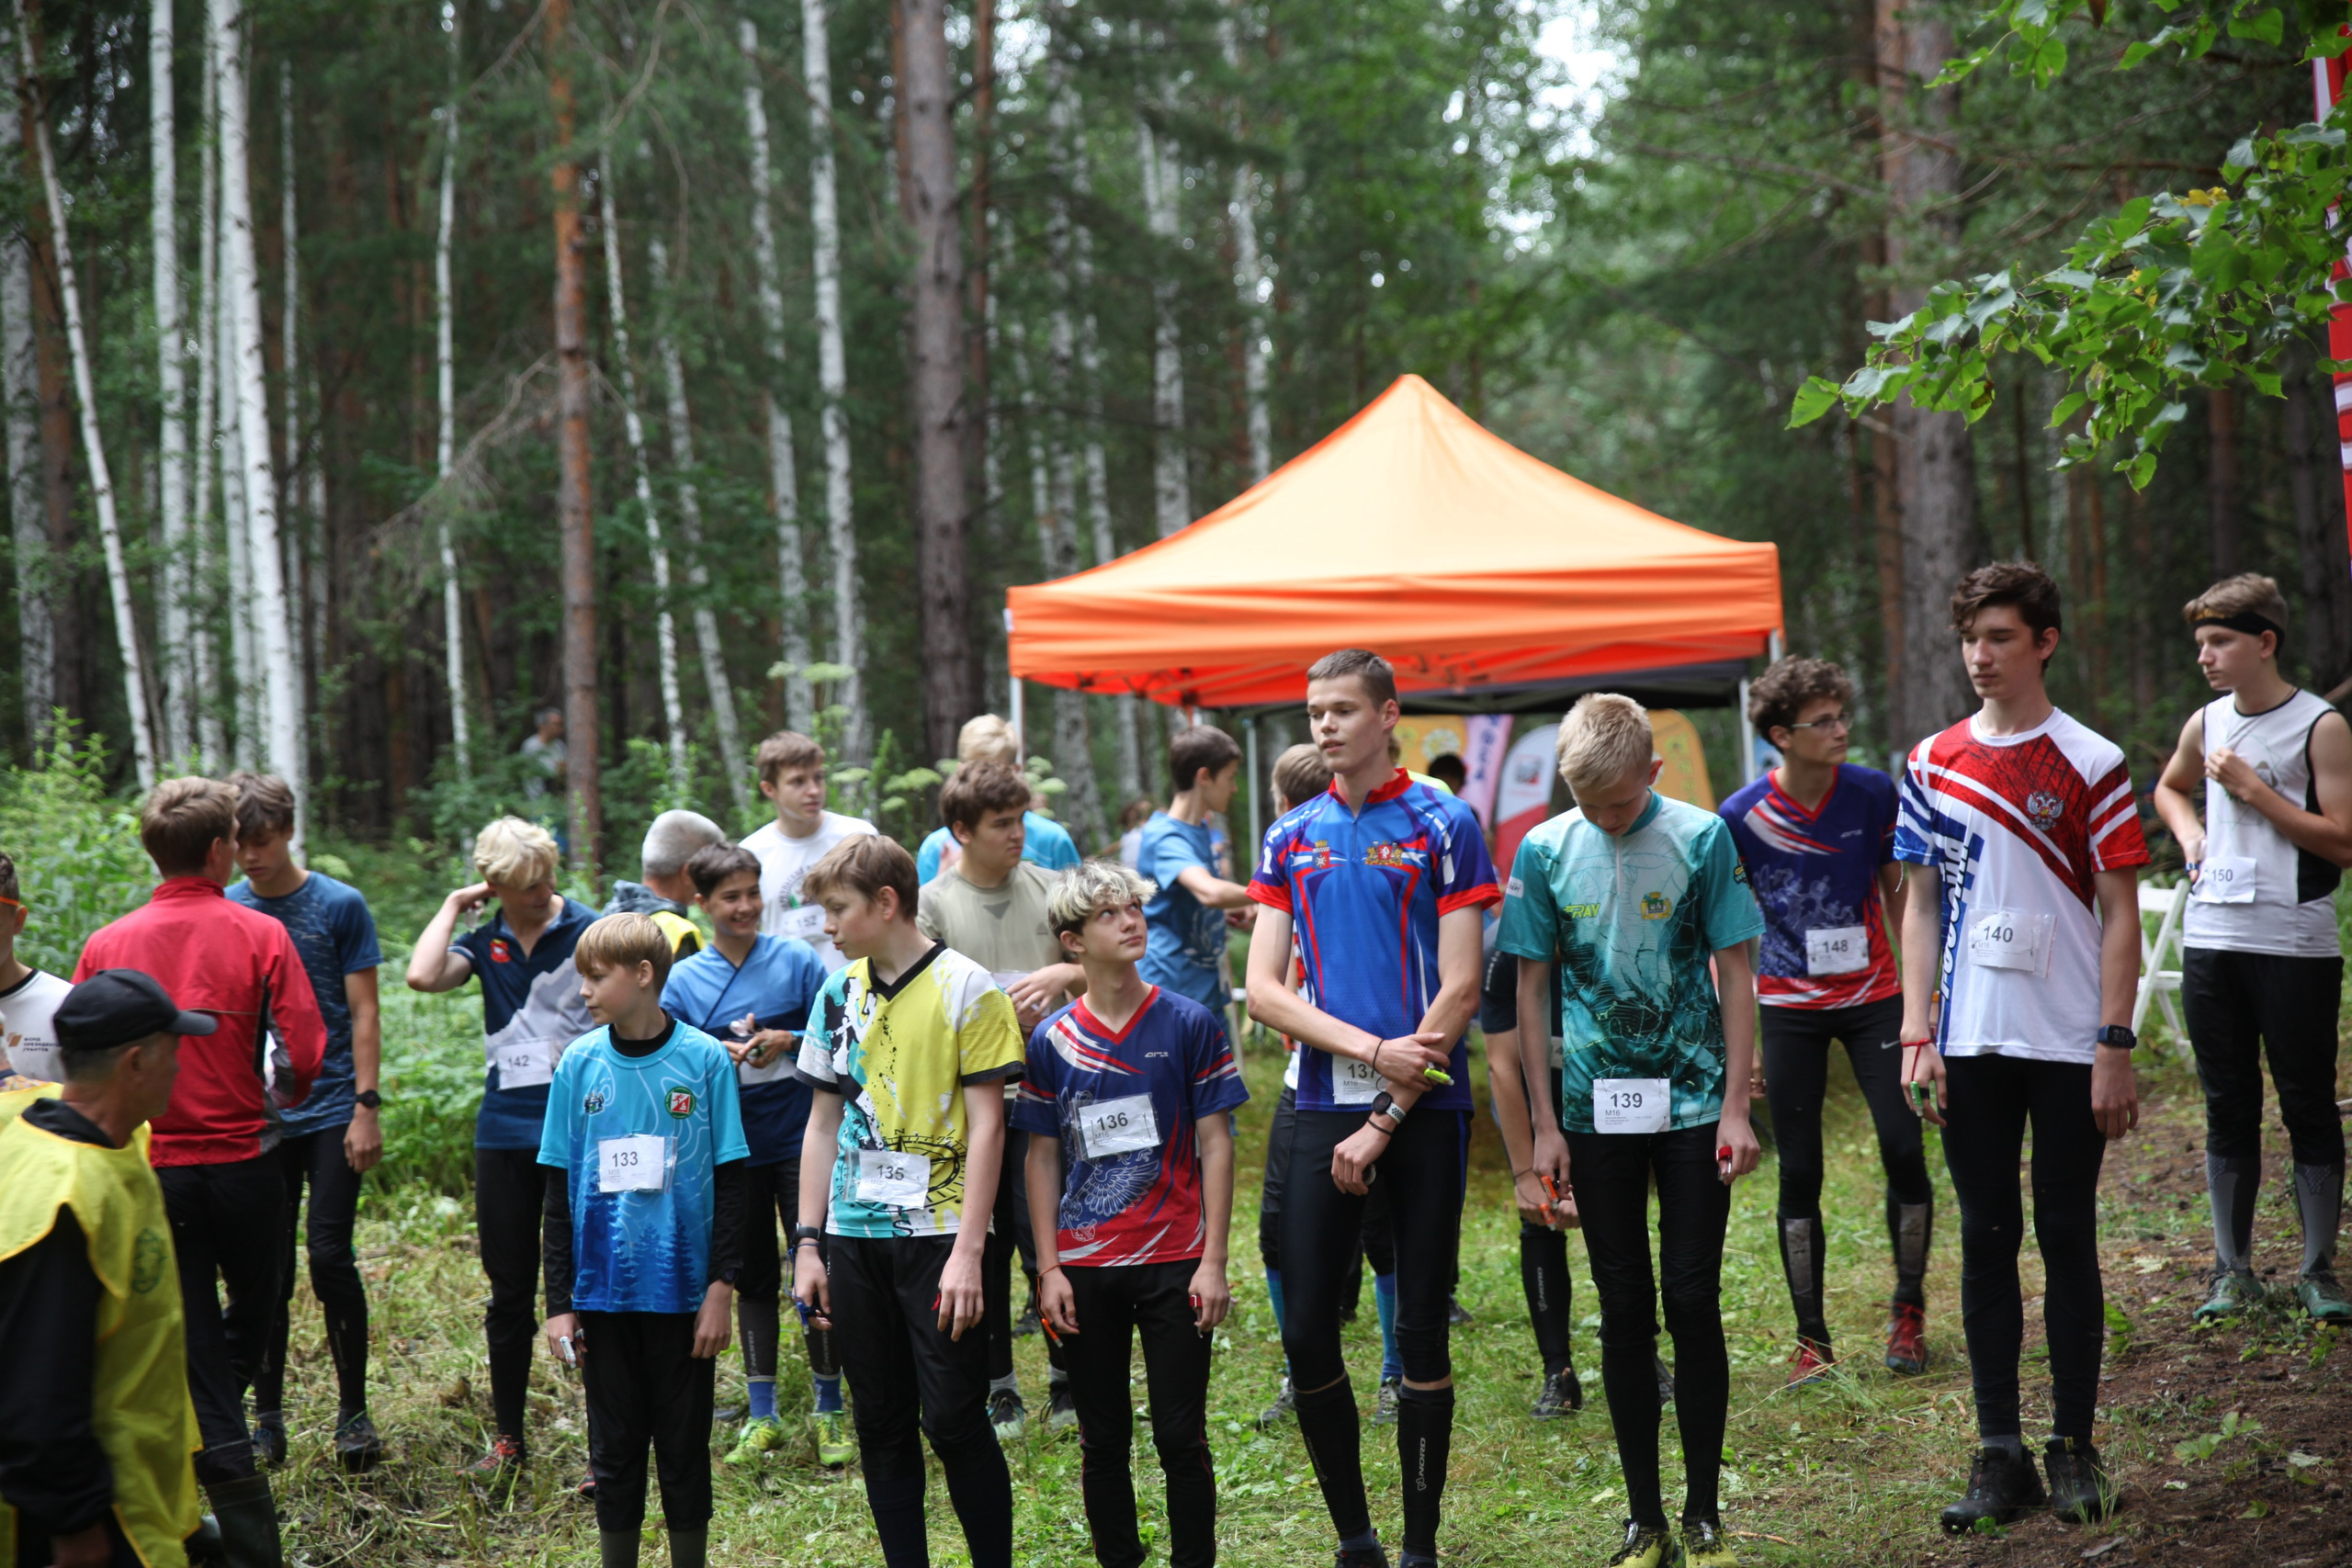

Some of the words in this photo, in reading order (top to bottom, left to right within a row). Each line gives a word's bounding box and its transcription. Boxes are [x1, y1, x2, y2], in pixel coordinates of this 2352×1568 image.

[2212, 869, 2233, 882] 150
[1984, 926, 2013, 942] 140
[1823, 940, 1849, 953] 148
[508, 1055, 529, 1067] 142
[1611, 1093, 1643, 1108] 139
[1097, 1112, 1128, 1131] 136
[612, 1151, 639, 1168] 133
[876, 1164, 905, 1180] 135
[1417, 1437, 1427, 1477] NORD
